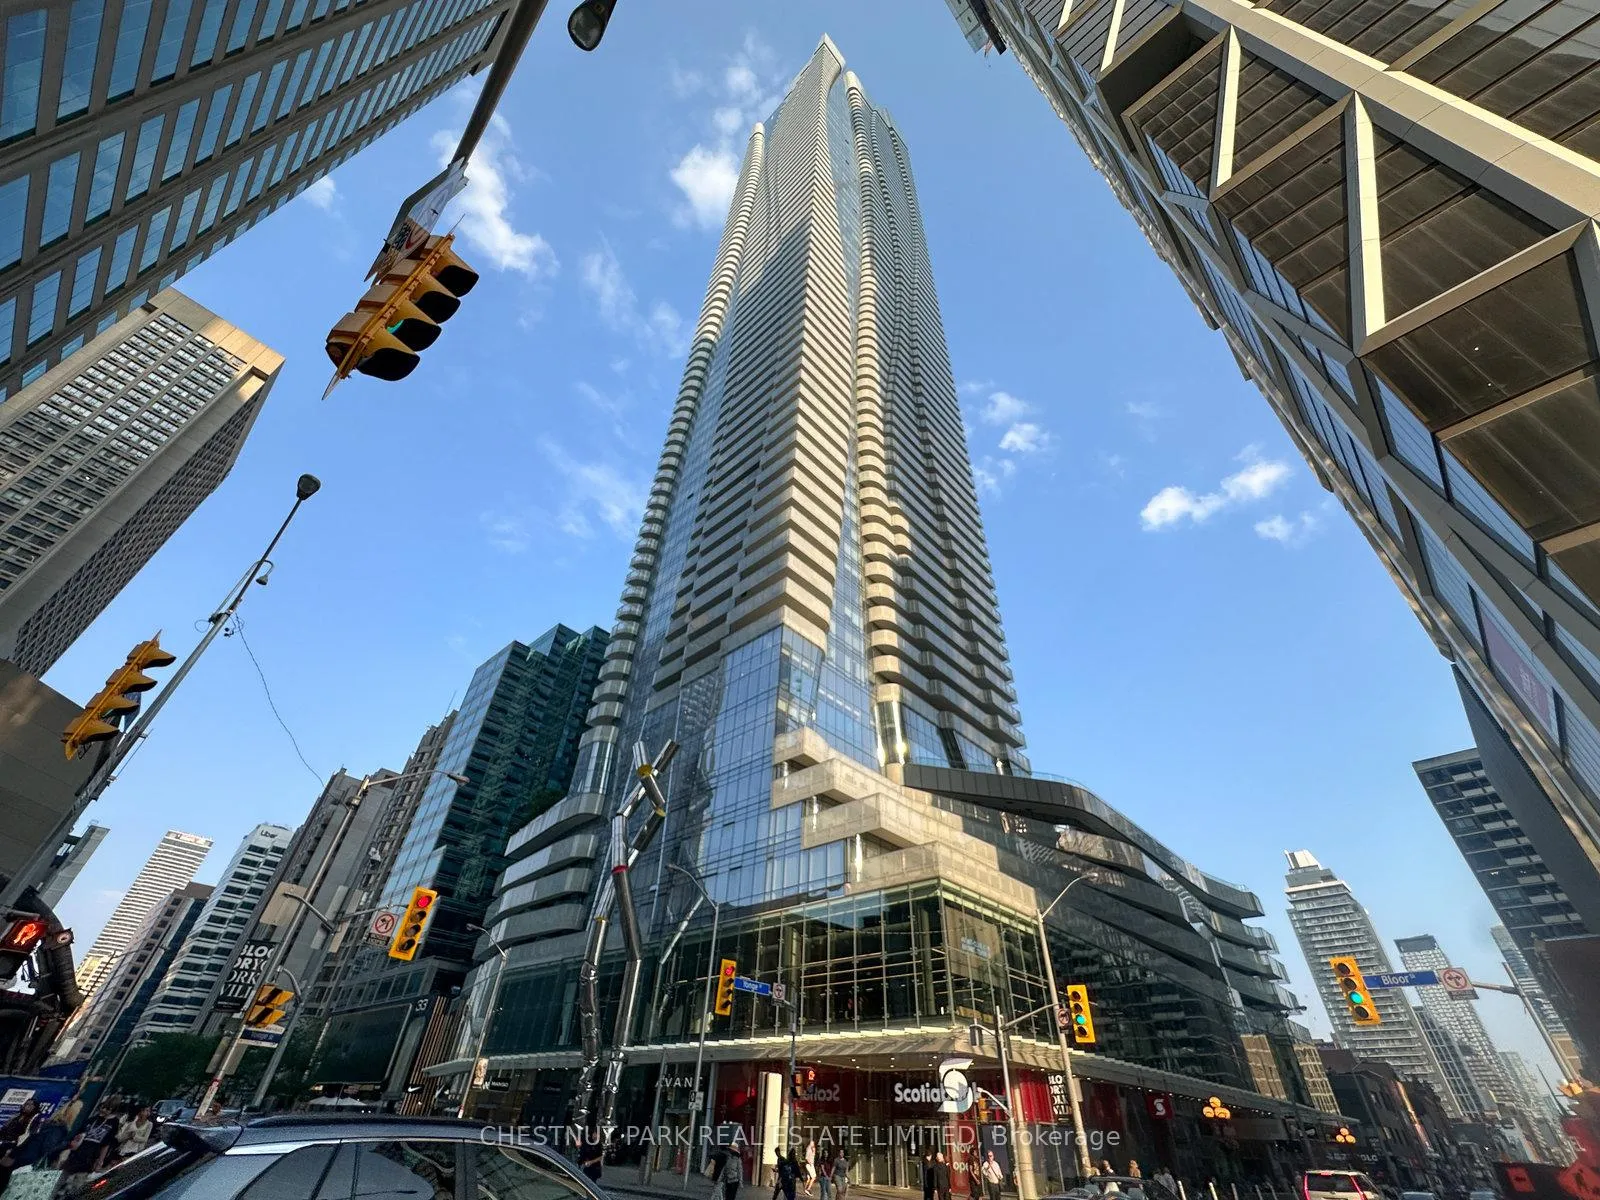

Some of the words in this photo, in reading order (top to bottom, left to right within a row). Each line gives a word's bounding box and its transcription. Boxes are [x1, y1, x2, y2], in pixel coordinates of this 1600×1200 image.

[261, 830, 278, 839] Uber
[1381, 974, 1410, 985] Bloor
[415, 999, 428, 1011] 33
[655, 1077, 703, 1088] AVAN
